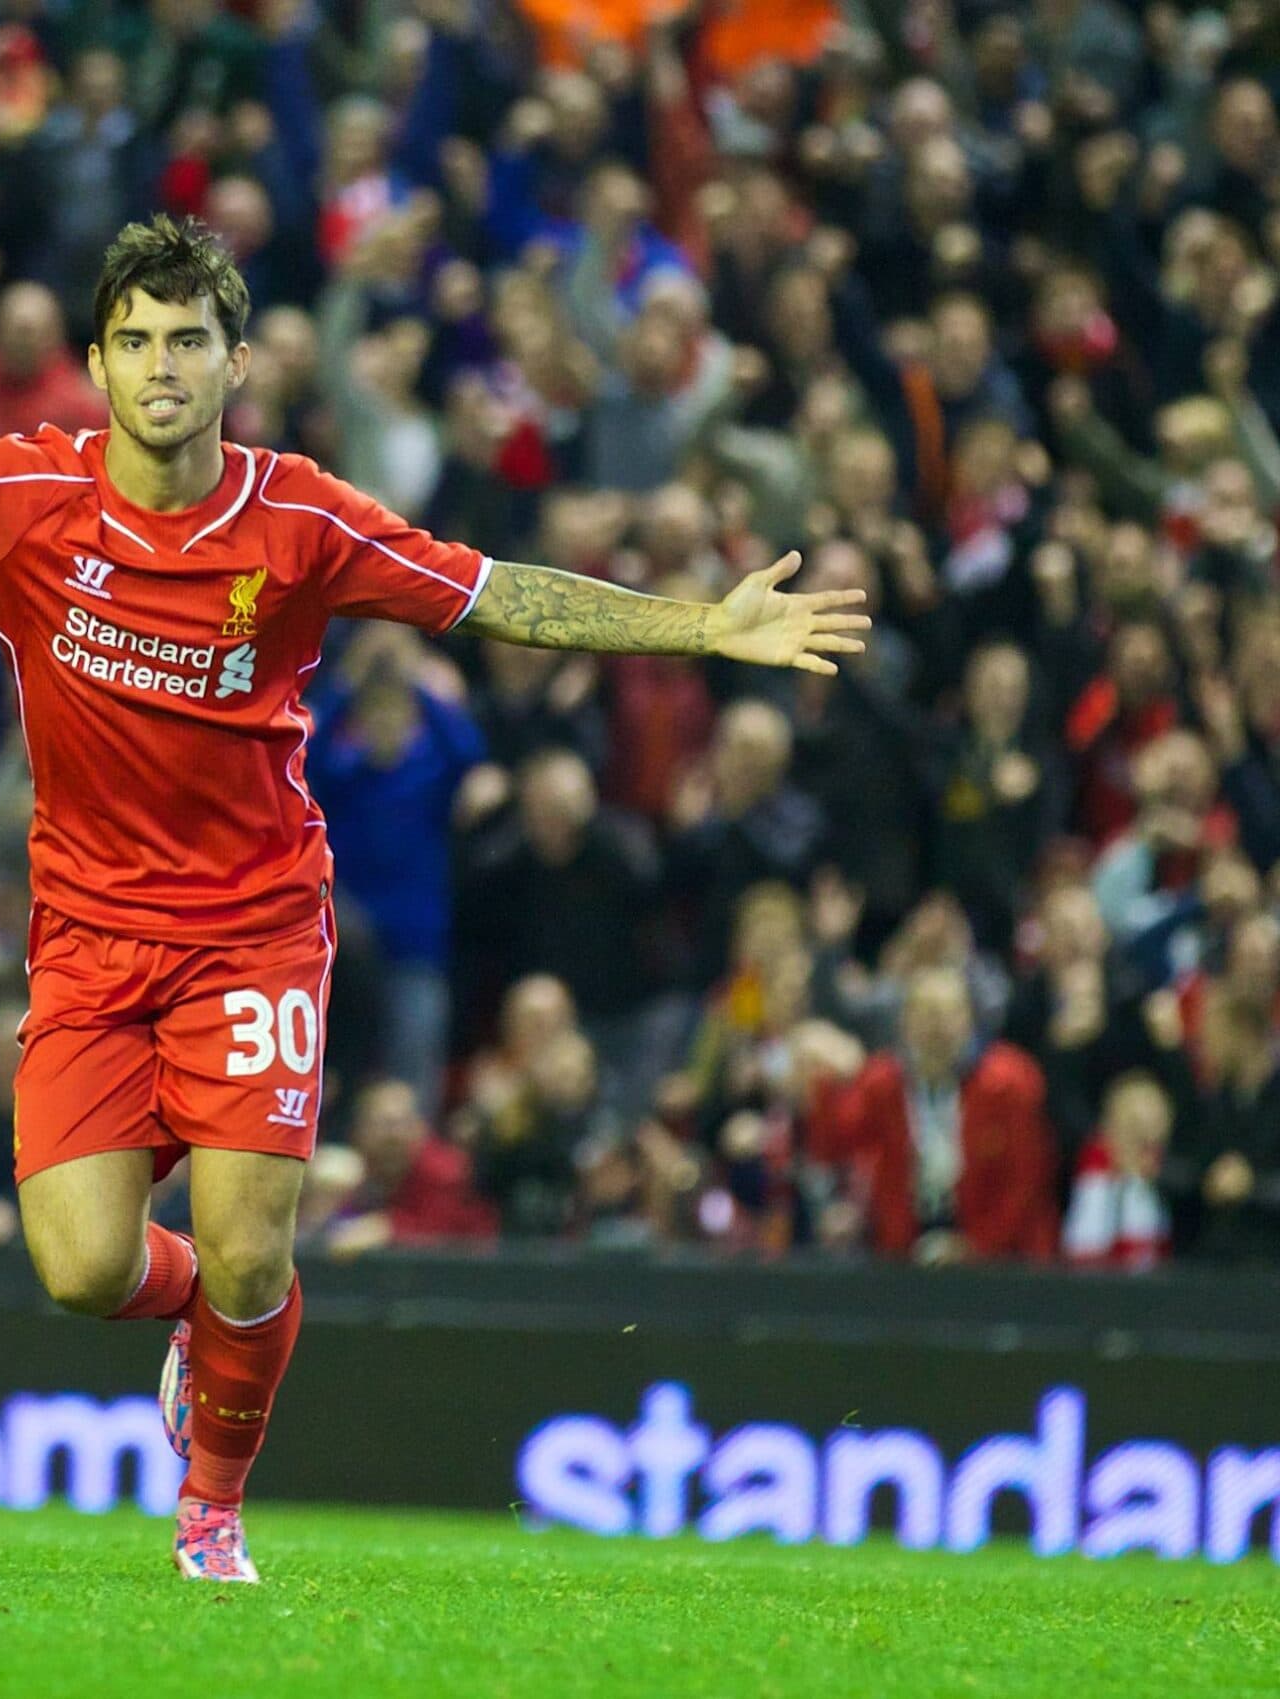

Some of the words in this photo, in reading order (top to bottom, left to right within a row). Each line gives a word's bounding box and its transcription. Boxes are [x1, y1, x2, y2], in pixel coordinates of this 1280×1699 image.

[51, 633, 208, 699] Chartered
[65, 606, 215, 670] Standard
[223, 988, 317, 1076] 30
[518, 1379, 1280, 1565] standar
